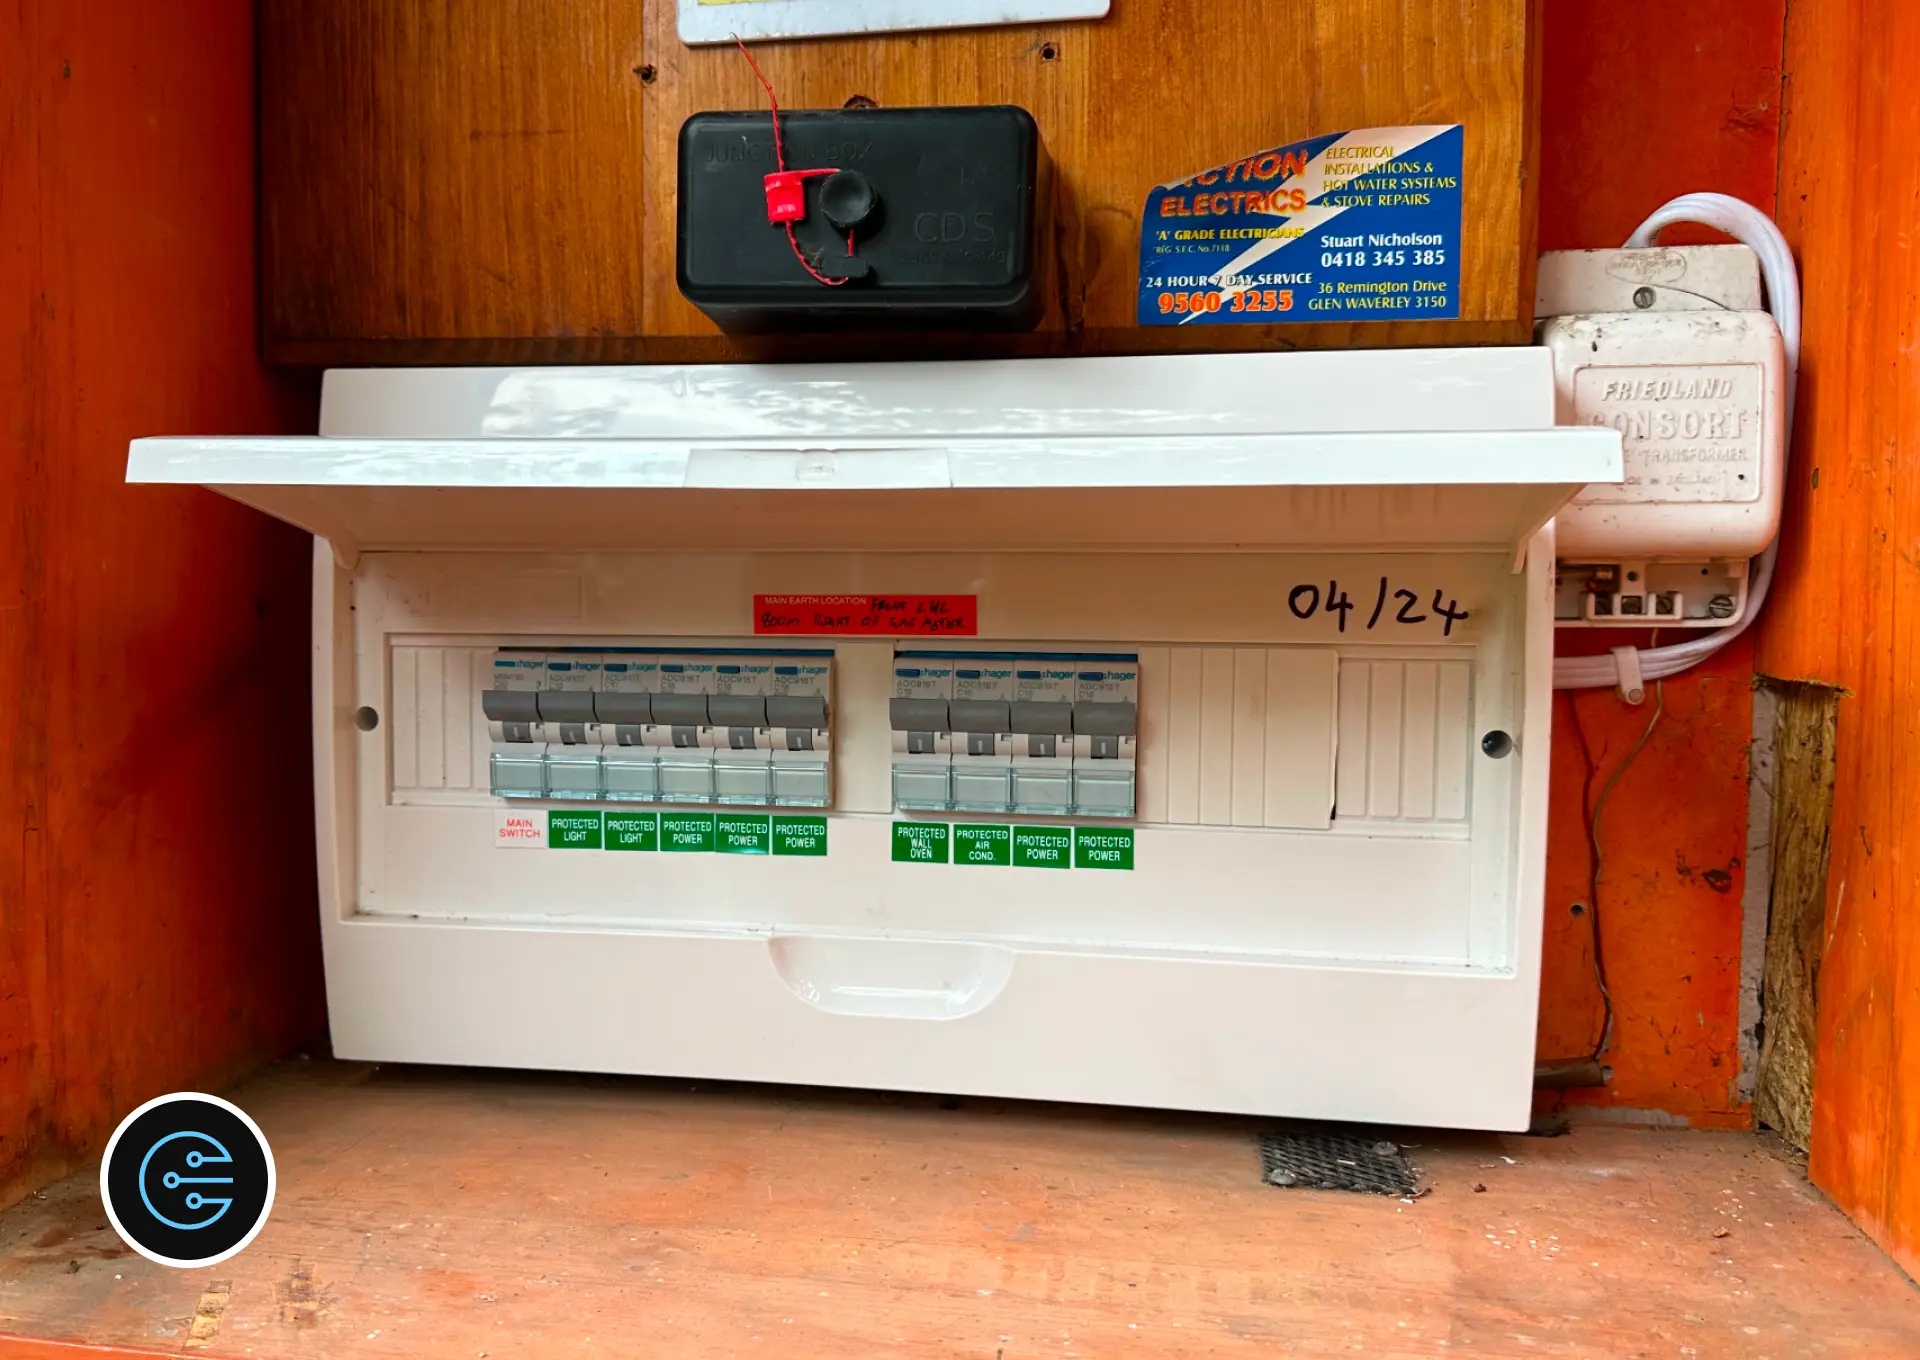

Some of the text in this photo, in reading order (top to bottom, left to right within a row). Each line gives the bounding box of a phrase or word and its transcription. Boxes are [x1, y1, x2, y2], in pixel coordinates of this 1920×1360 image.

[704, 142, 873, 164] JUNCTON BOX
[1326, 146, 1393, 160] ELECTRICAL
[1184, 150, 1308, 188] CTION
[1324, 162, 1434, 176] INSTALLATIONS &
[1323, 176, 1457, 192] HOT WATER SYSTEMS
[1160, 188, 1307, 217] ELECTRICS
[1321, 193, 1430, 208] & STOVE REPAIRS
[914, 212, 996, 243] CDS
[1174, 229, 1216, 241] GRADE
[1219, 227, 1305, 240] ELECTRICIANS
[1321, 232, 1442, 248] Stuart Nicholson
[1321, 249, 1446, 268] 0418 345 385
[1146, 276, 1162, 288] 24
[1167, 275, 1207, 287] HOUR
[1226, 274, 1254, 286] DAY
[1255, 272, 1312, 285] SERVICE
[1318, 280, 1447, 294] 36 Remington Drive
[1158, 289, 1293, 314] 9560 3255
[1308, 296, 1447, 310] GLEN WAVERLEY 3150
[1601, 377, 1732, 401] FRIEDLAND
[765, 597, 866, 605] MAIN EARTH LOCATION
[506, 819, 533, 828] MAIN
[551, 819, 599, 829] PROTECTED
[607, 821, 655, 832] PROTECTED
[663, 821, 712, 832] PROTECTED
[719, 823, 768, 834] PROTECTED
[499, 828, 541, 839] SWITCH
[563, 831, 587, 841] LIGHT
[776, 825, 825, 836] PROTECTED
[897, 827, 946, 839] PROTECTED
[956, 830, 1009, 840] PROTECTED
[619, 833, 643, 843] LIGHT
[673, 834, 703, 844] POWER
[728, 835, 758, 846] POWER
[785, 837, 816, 848] POWER
[1016, 835, 1069, 848] PROTECTED
[1078, 836, 1132, 848] PROTECTED
[911, 839, 932, 849] WALL
[975, 841, 991, 850] AIR
[910, 848, 932, 859] OVEN
[968, 851, 996, 861] COND.
[1027, 849, 1059, 860] POWER
[1088, 850, 1121, 861] POWER
